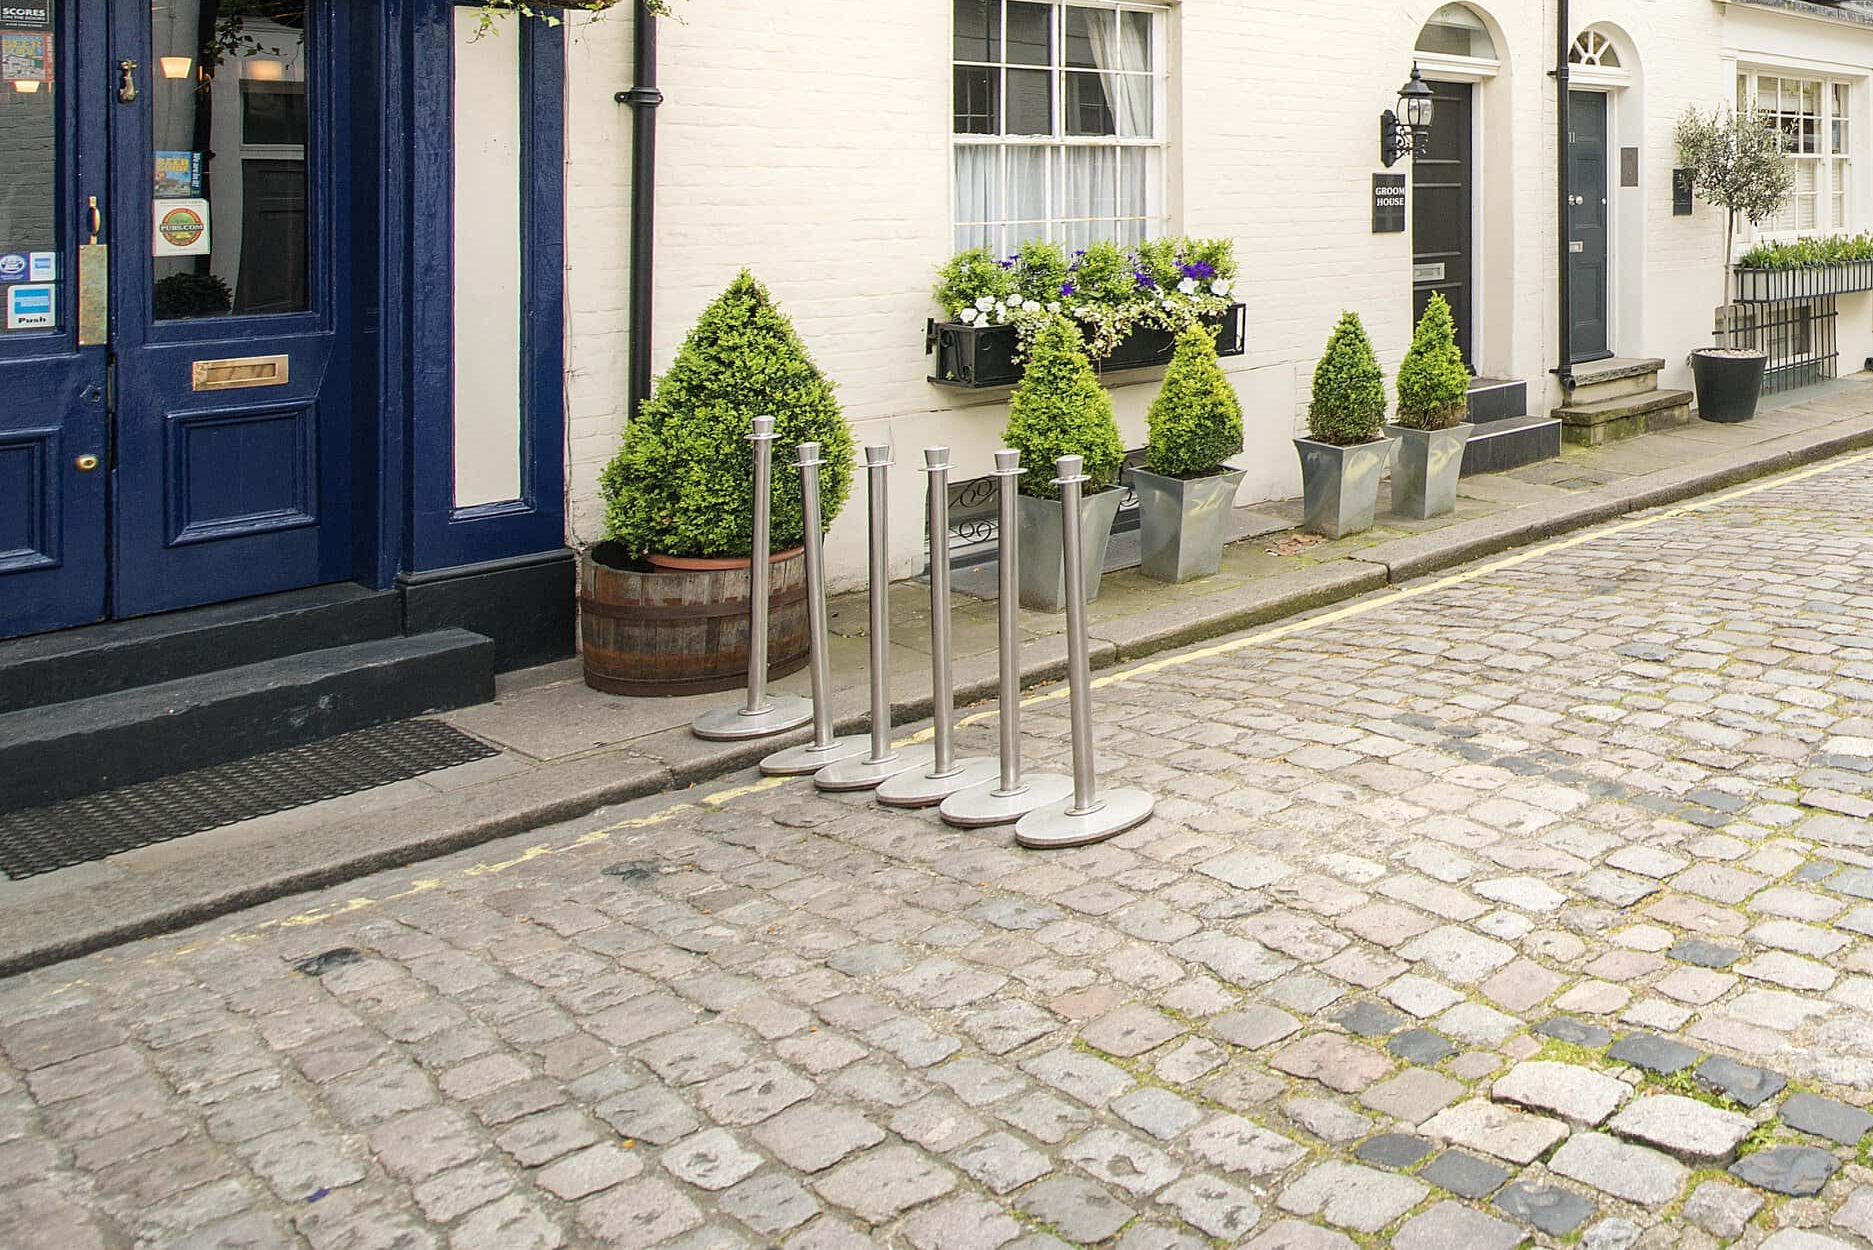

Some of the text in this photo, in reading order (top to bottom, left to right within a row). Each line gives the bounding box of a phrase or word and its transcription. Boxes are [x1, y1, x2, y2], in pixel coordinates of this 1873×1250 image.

[2, 7, 46, 17] SCORES
[1375, 186, 1405, 196] GROOM
[1376, 197, 1405, 207] HOUSE
